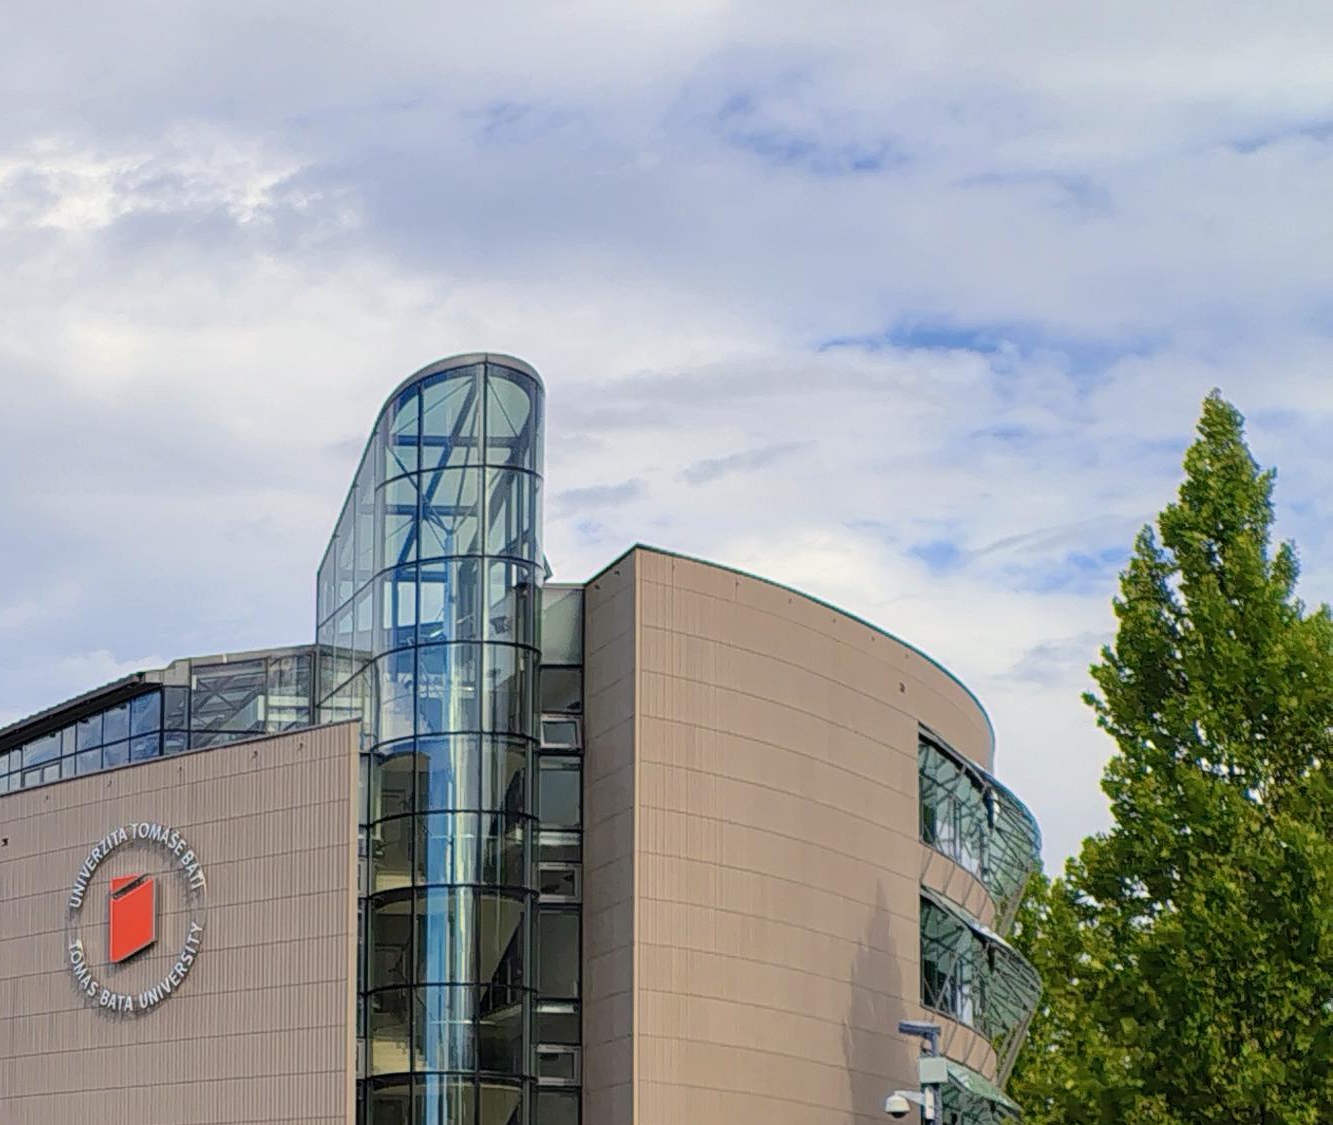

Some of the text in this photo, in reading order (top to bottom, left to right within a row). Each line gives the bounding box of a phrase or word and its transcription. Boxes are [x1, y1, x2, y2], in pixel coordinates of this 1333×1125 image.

[69, 828, 128, 908] UNIVERZITA
[181, 850, 206, 890] BATI
[69, 921, 204, 1012] TOMAS BATA UNIVERSITY
